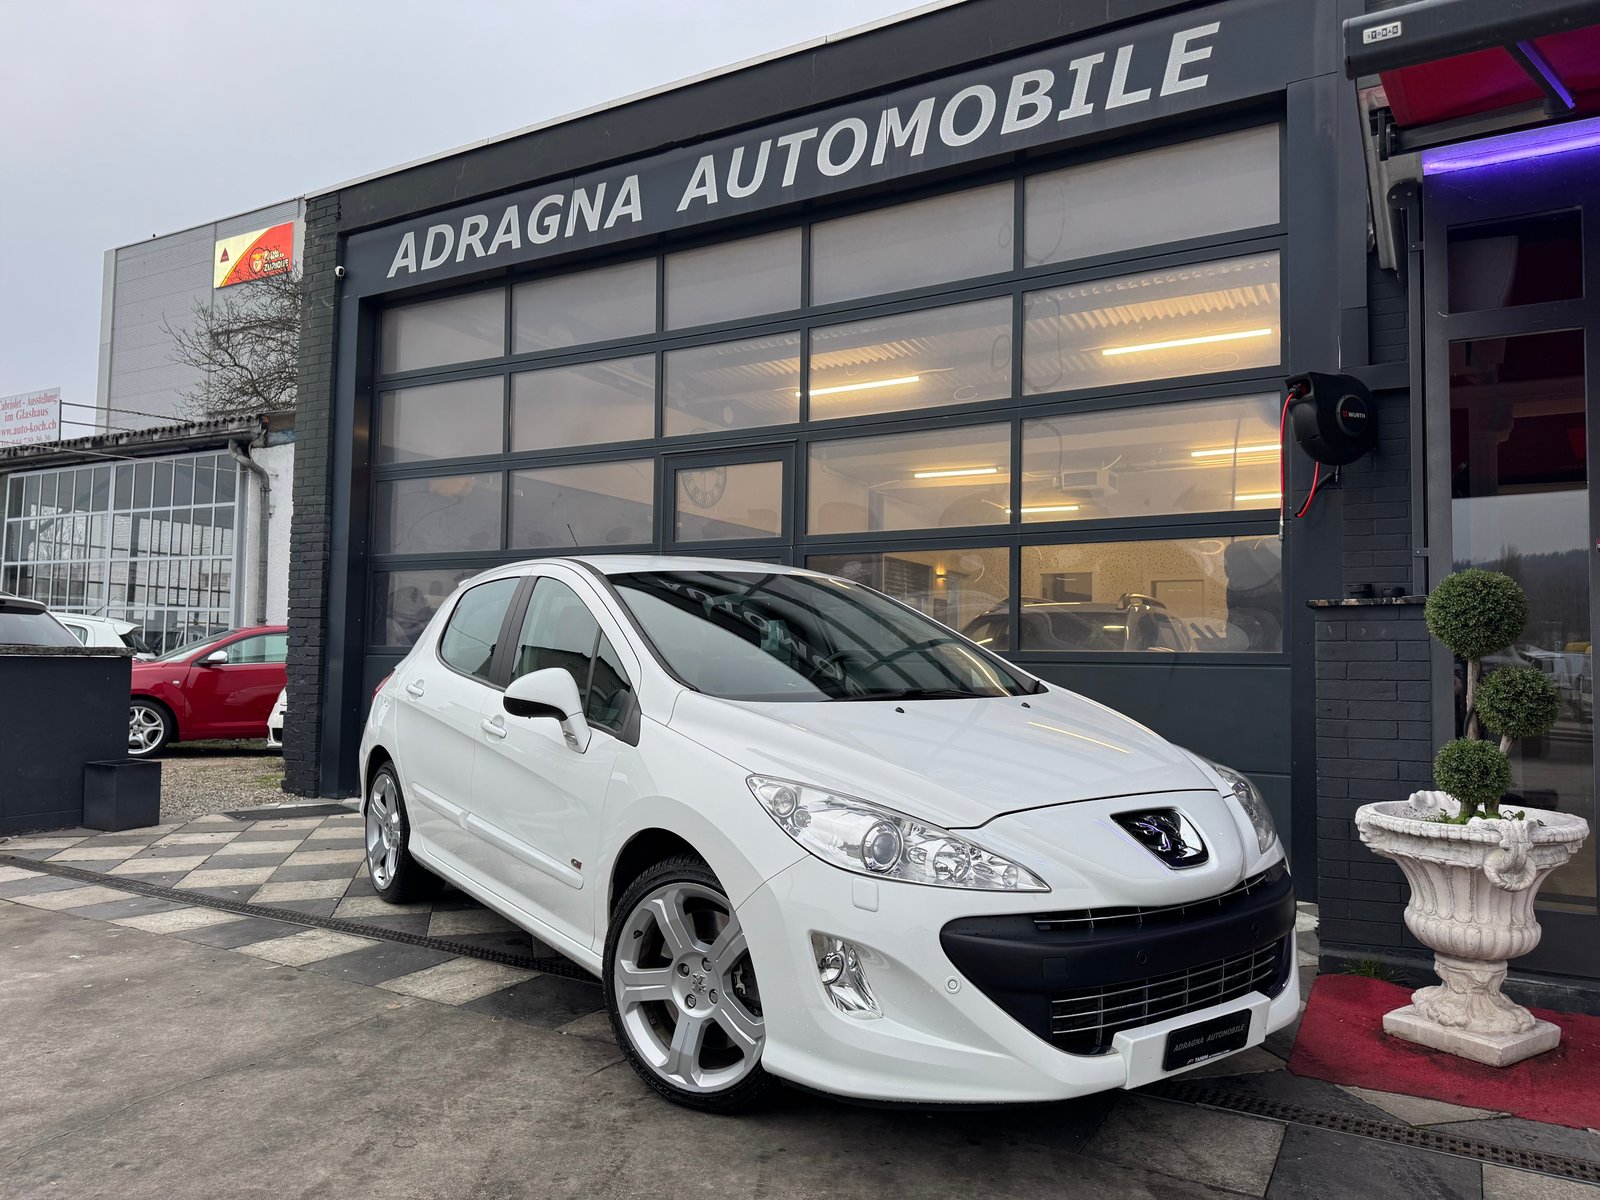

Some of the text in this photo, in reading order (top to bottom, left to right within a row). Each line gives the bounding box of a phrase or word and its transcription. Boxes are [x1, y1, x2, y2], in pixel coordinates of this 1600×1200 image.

[387, 22, 1221, 278] ADRAGNA AUTOMOBILE
[5, 408, 48, 422] im Glashaus
[1173, 1037, 1204, 1053] ADRAGNA
[1206, 1023, 1246, 1042] AUTOMOBILE
